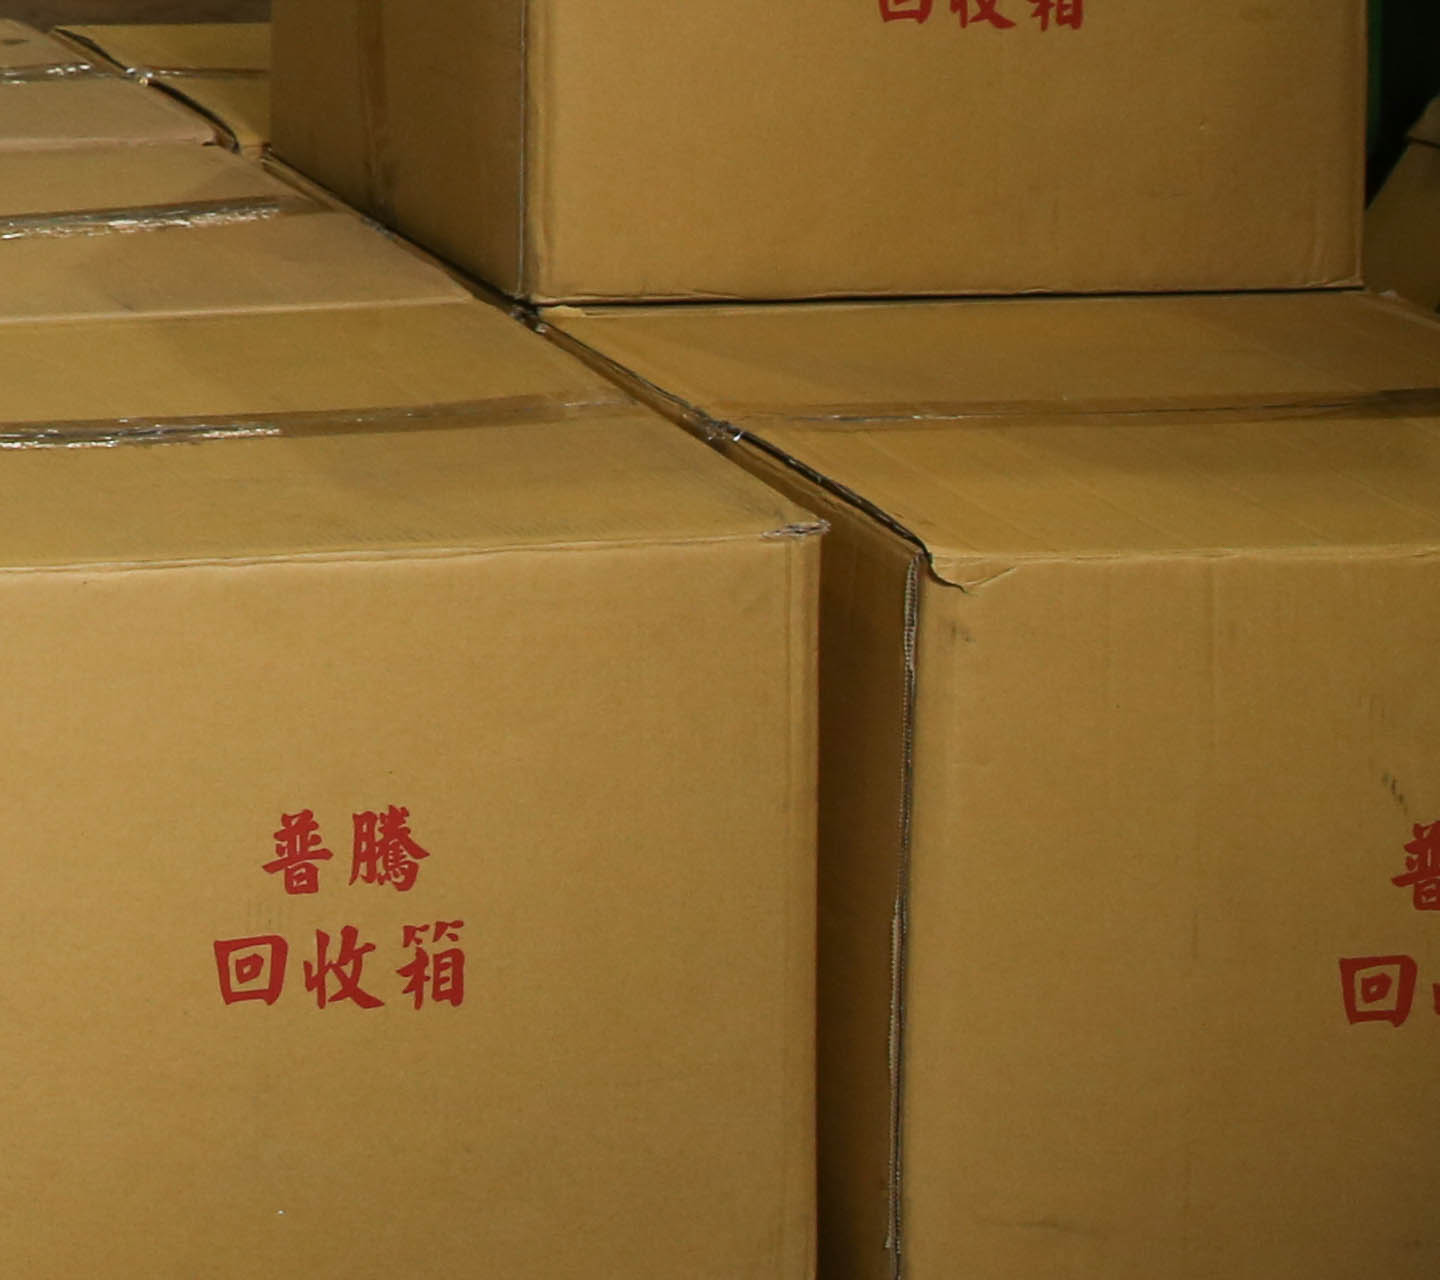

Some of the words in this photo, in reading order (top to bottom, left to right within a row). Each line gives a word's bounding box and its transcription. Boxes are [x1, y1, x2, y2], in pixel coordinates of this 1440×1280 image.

[262, 804, 431, 895] 普騰
[213, 919, 465, 1010] 回收箱
[1339, 955, 1440, 1028] 回
